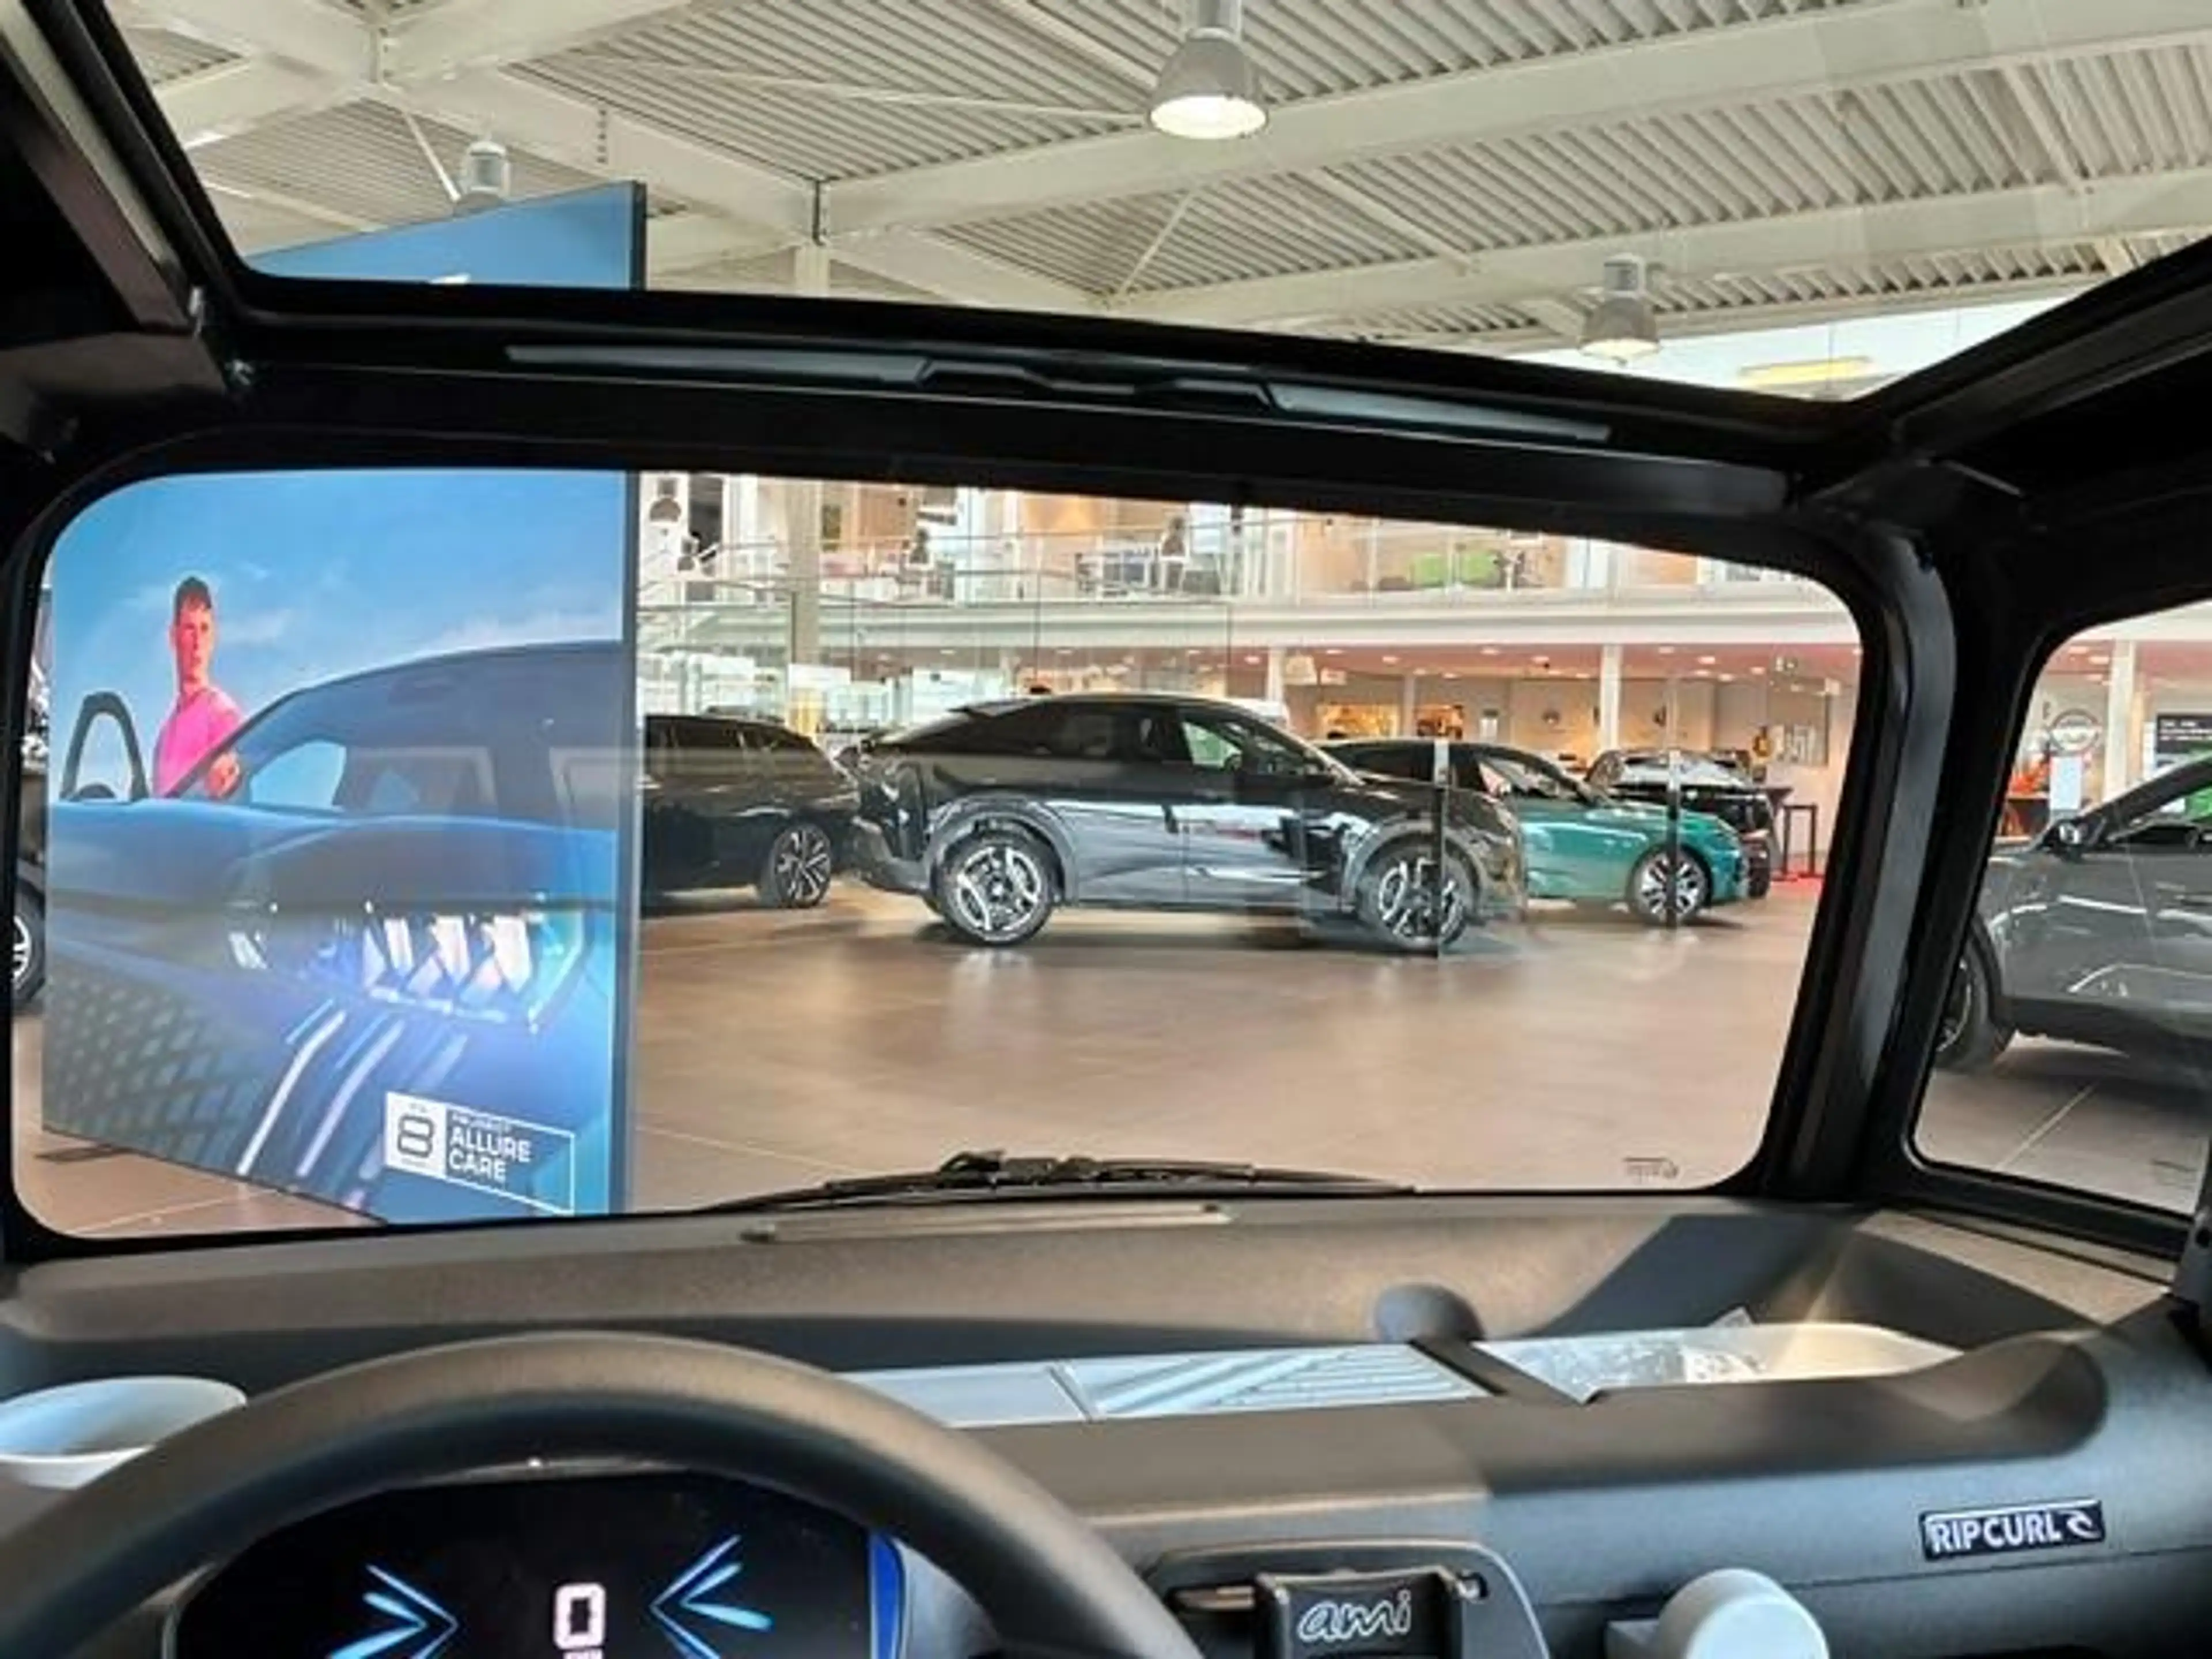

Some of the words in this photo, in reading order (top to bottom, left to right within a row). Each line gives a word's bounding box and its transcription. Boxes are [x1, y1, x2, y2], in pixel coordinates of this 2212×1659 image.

[397, 1113, 435, 1158] 8
[450, 1126, 531, 1162] ALLURE
[449, 1148, 506, 1181] CARE
[554, 1582, 605, 1649] 0
[1297, 1589, 1411, 1643] ami
